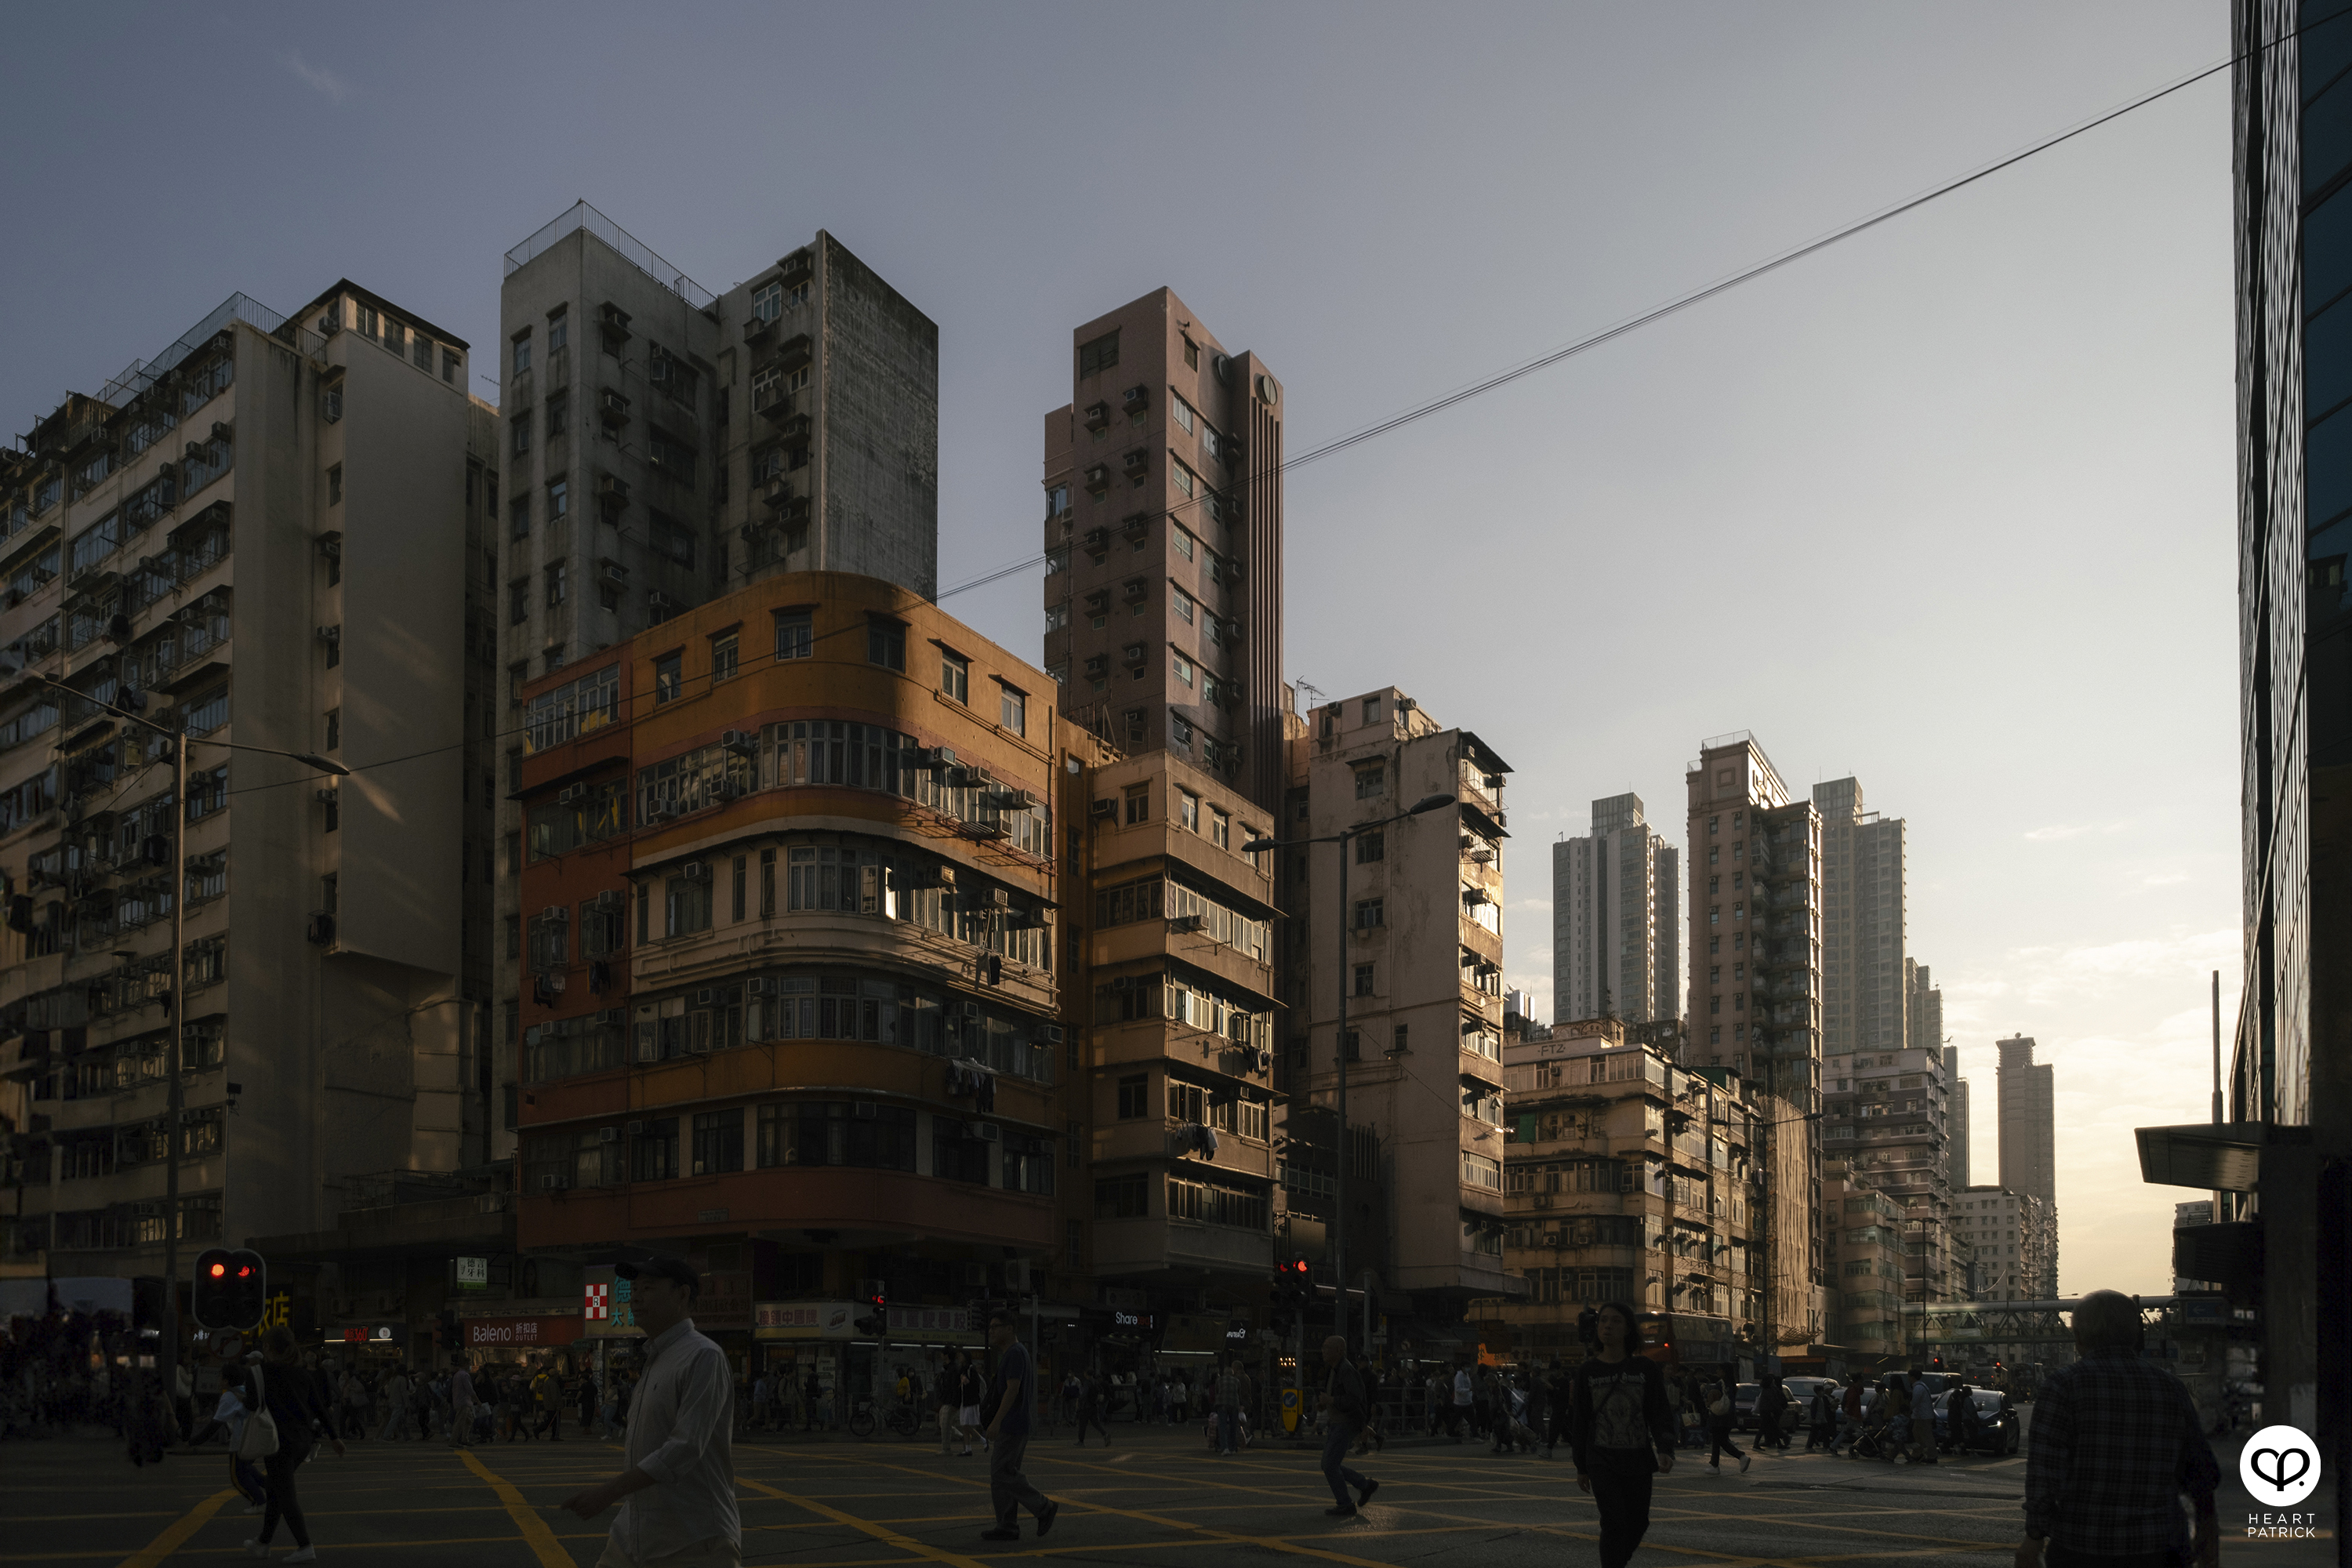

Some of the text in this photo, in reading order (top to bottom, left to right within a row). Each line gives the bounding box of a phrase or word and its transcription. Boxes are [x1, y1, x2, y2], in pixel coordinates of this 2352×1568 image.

[474, 1323, 512, 1342] Baleno
[515, 1322, 538, 1334] 折扣店
